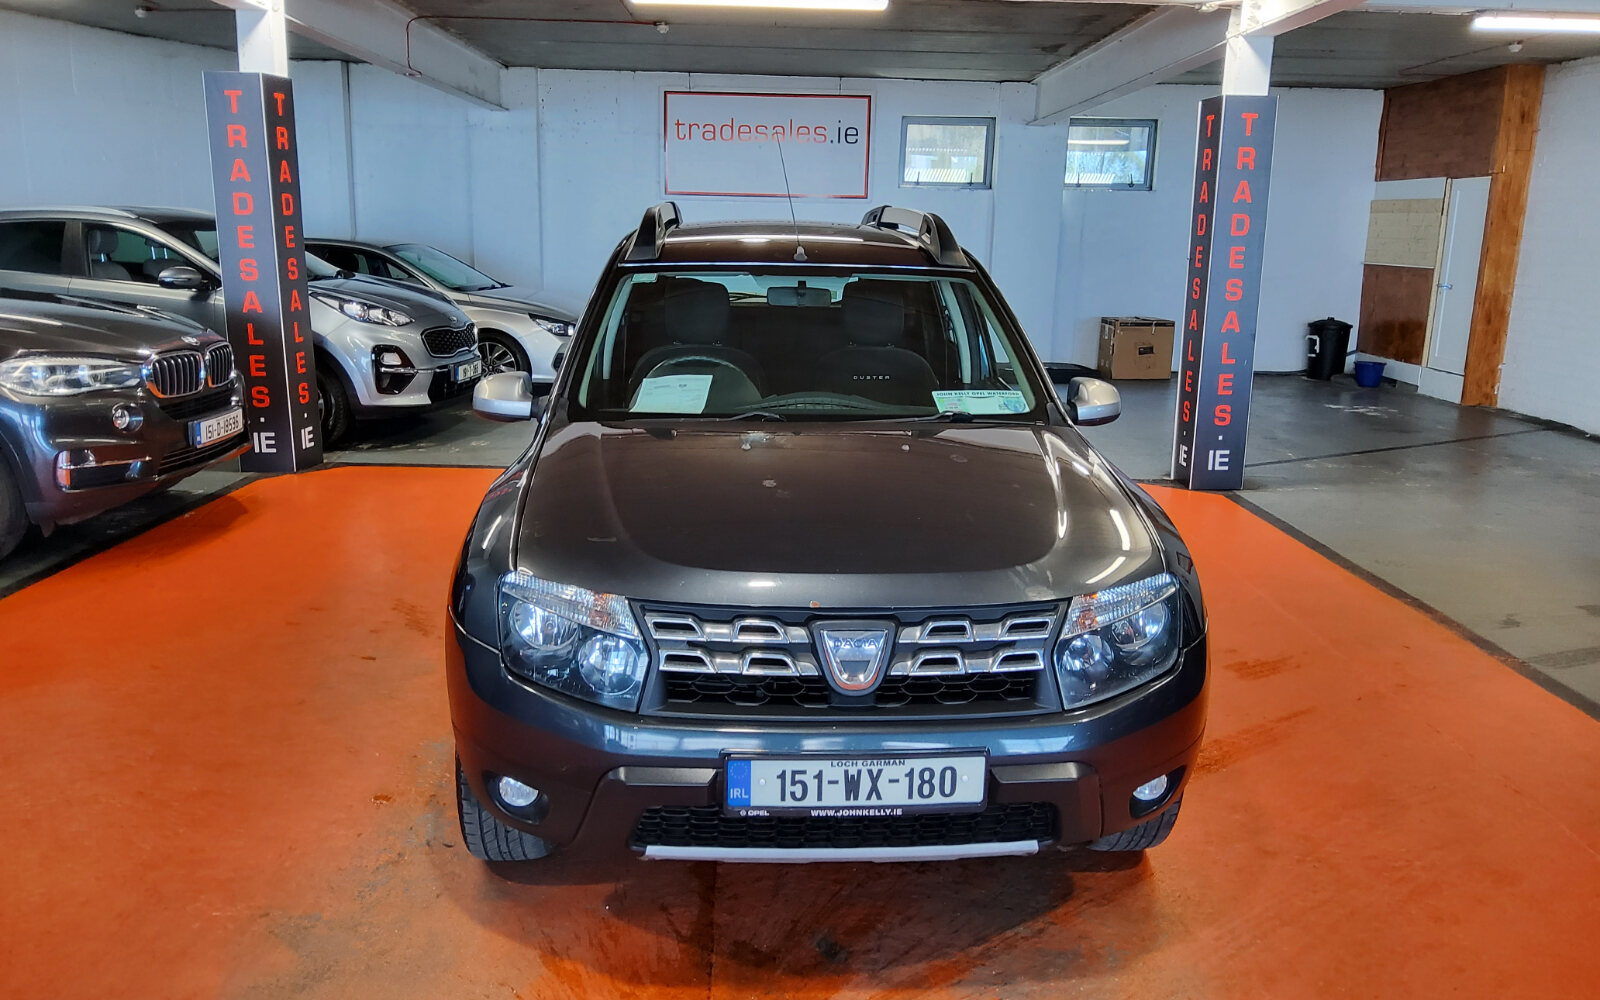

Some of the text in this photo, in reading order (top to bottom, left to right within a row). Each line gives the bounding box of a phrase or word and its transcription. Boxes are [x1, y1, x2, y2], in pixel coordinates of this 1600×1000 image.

[675, 117, 859, 144] tradesales.ie
[776, 766, 957, 802] 151-WX-180
[729, 787, 749, 799] IRL
[747, 809, 770, 817] OPEL
[810, 808, 903, 817] WWW.JOHNKELLY.IE
